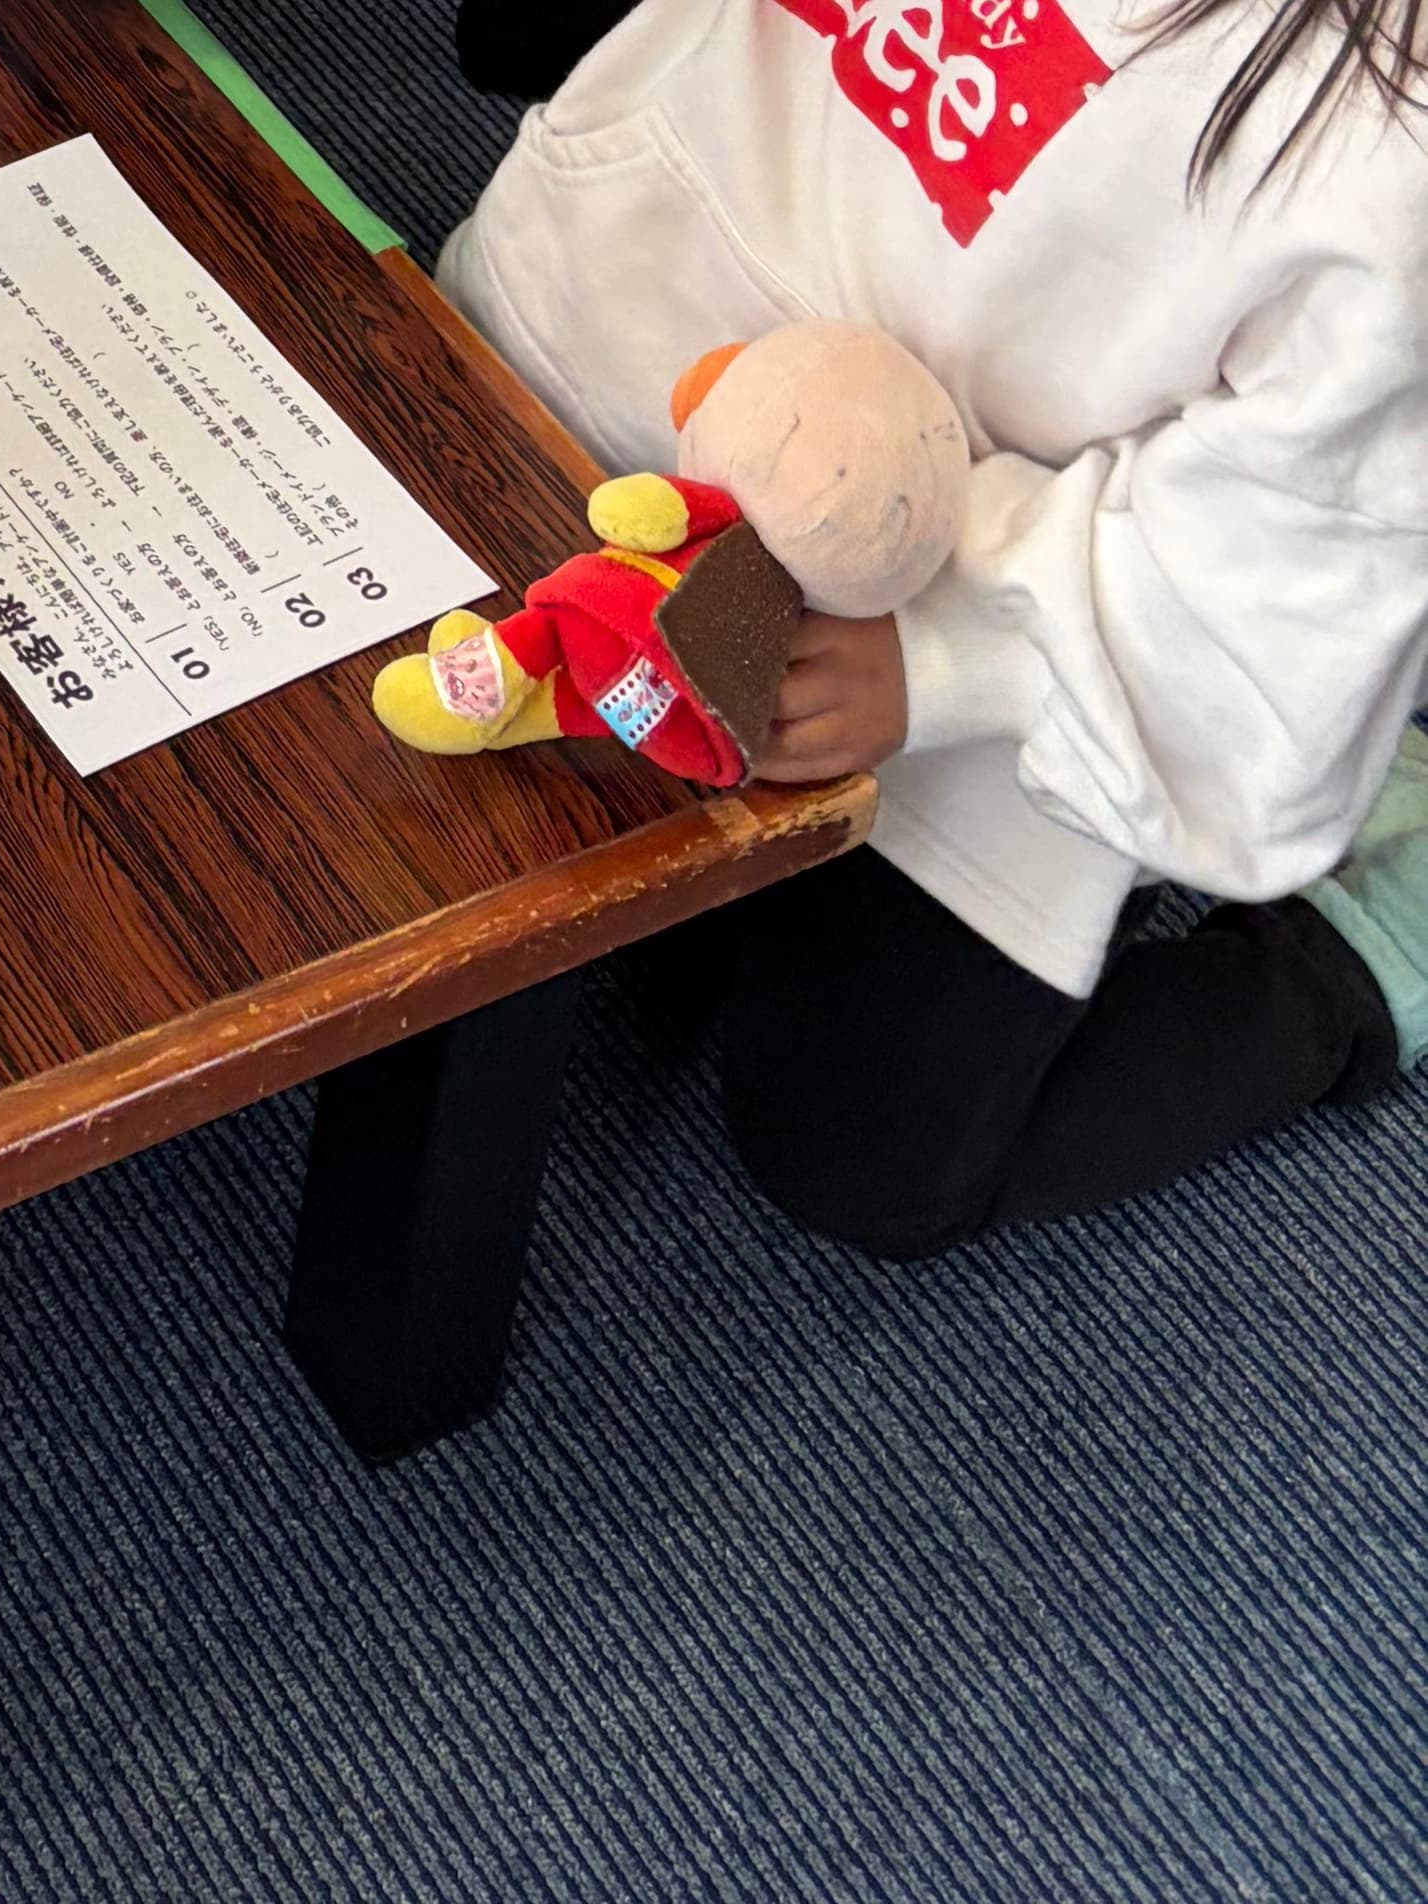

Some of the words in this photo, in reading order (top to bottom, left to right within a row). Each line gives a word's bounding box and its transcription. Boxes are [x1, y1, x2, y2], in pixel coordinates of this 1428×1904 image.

[19, 353, 148, 497] 下記の質問にご協力ください
[52, 479, 76, 499] NO
[6, 463, 147, 626] お家づくりをご計画中ですか？
[110, 550, 139, 576] YES
[343, 563, 392, 604] 03
[280, 590, 330, 631] 02
[167, 642, 215, 683] 01
